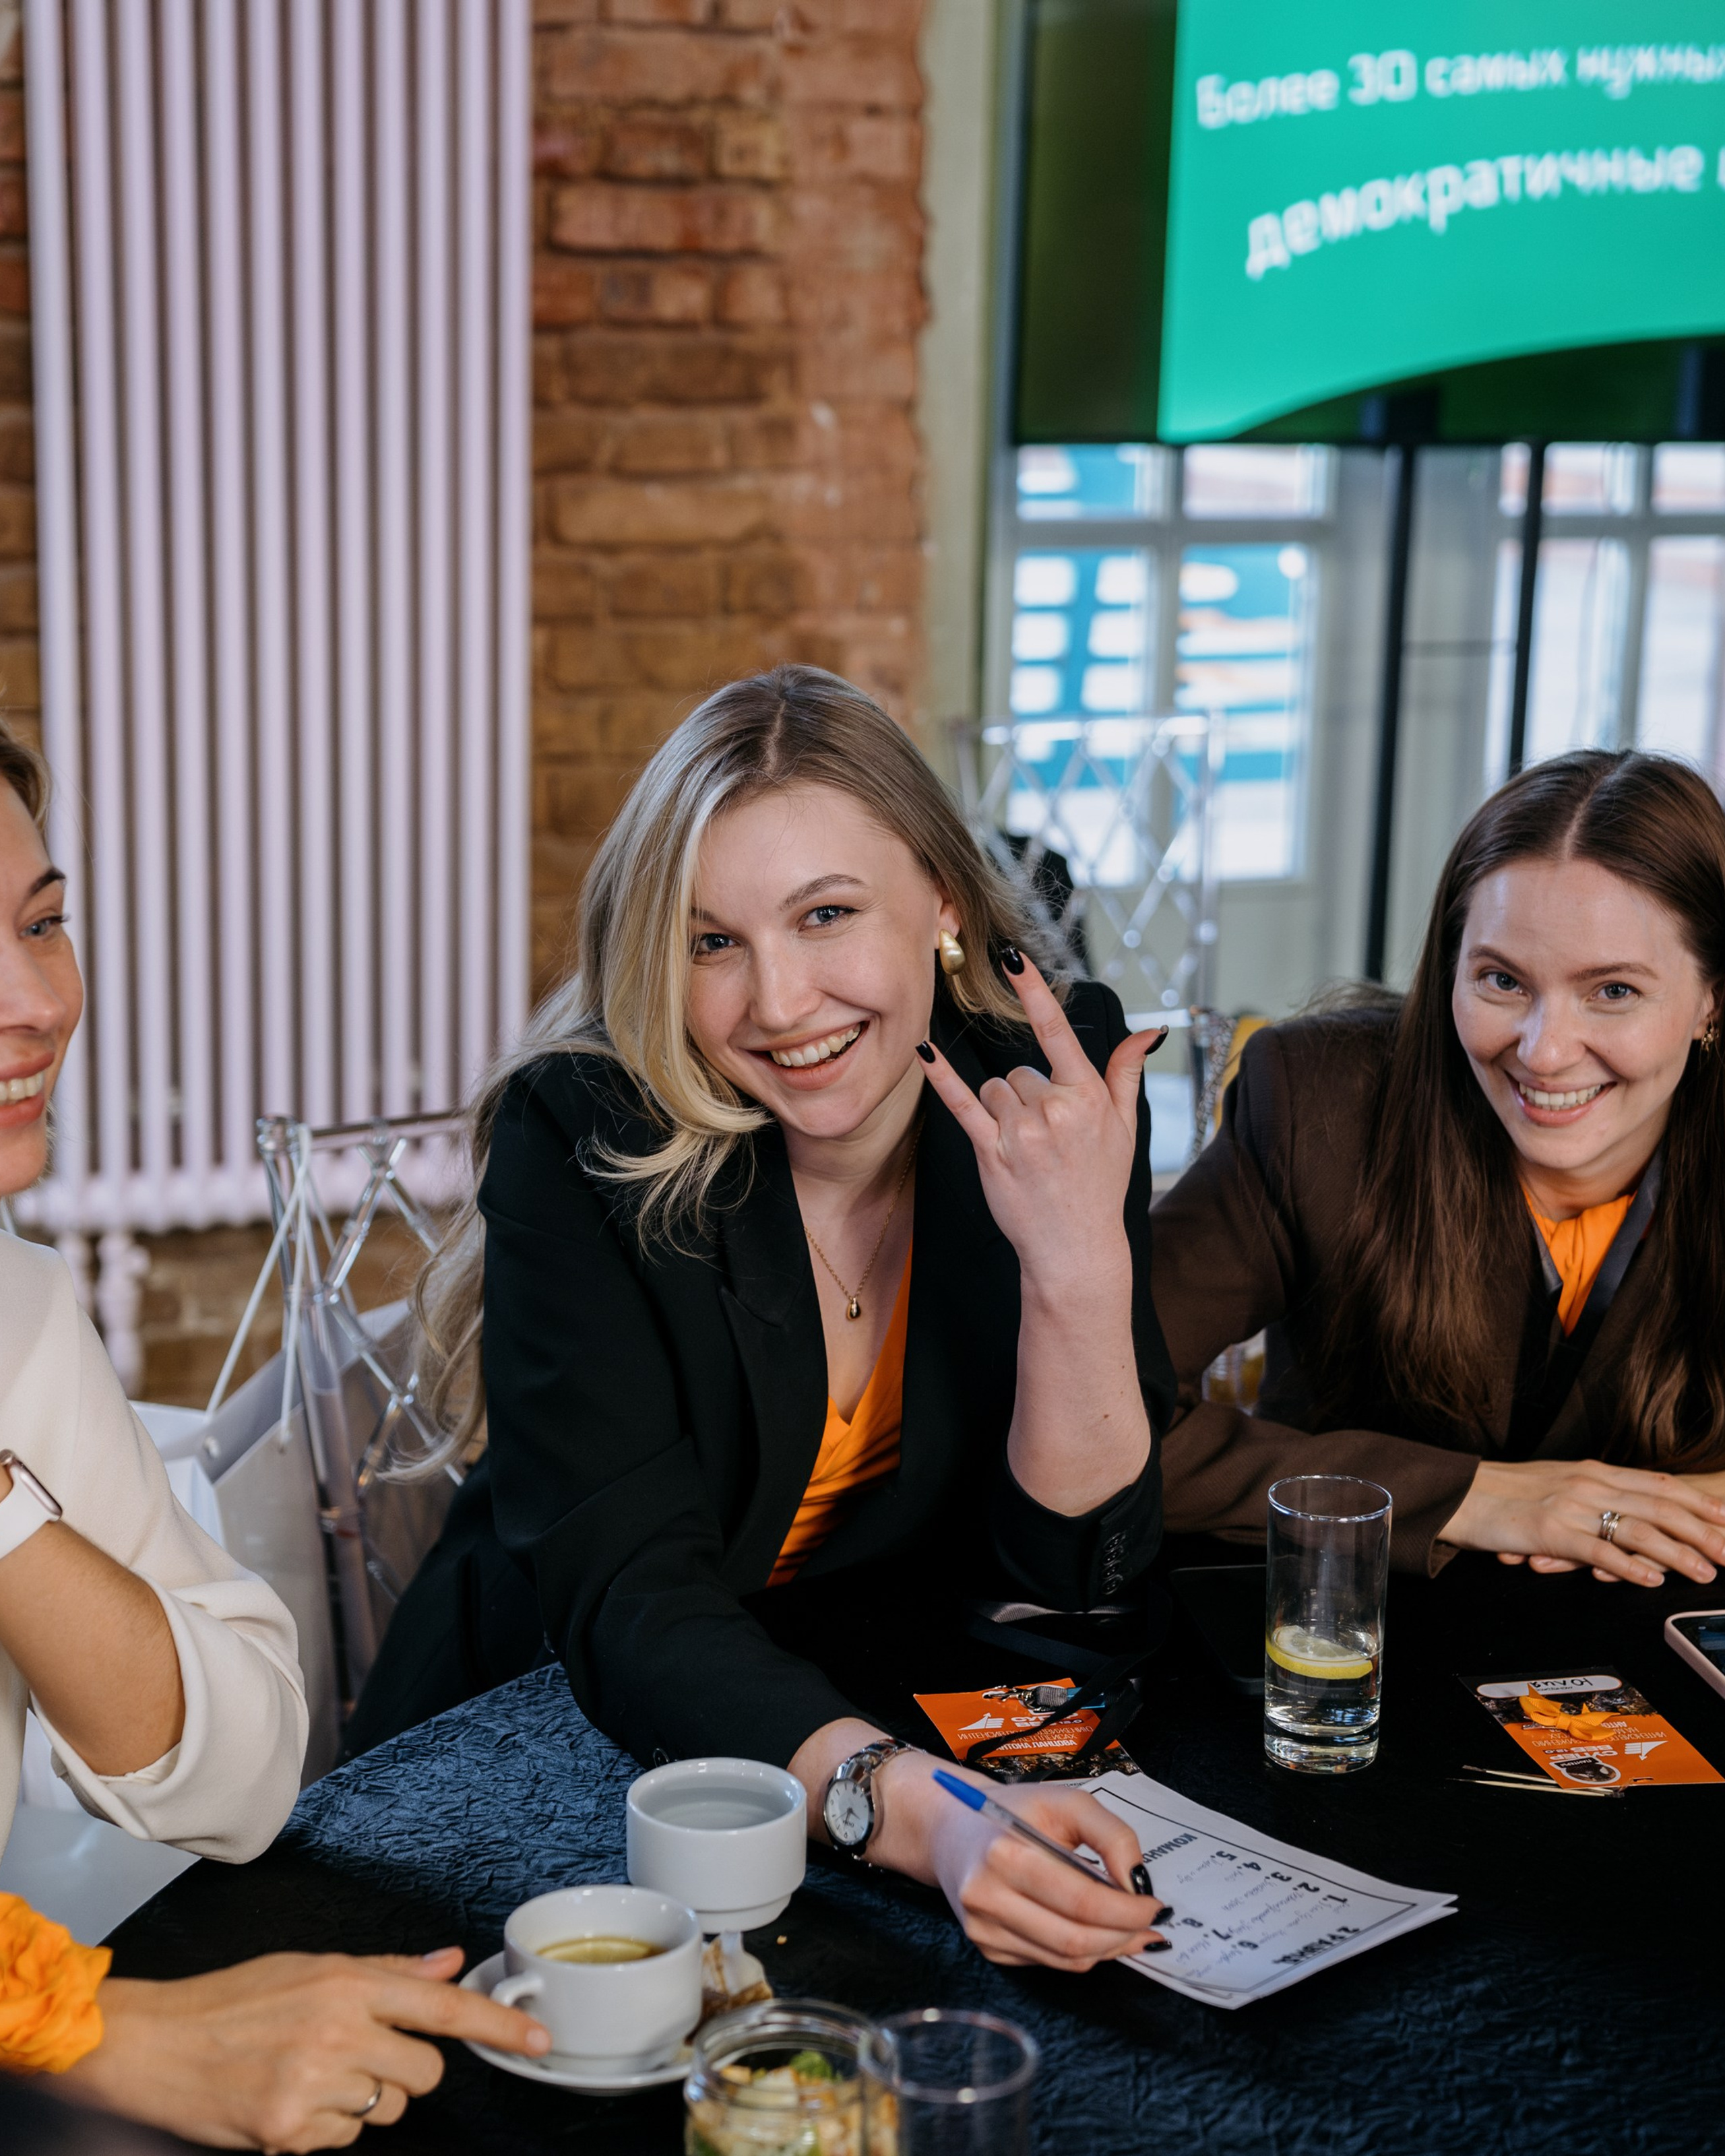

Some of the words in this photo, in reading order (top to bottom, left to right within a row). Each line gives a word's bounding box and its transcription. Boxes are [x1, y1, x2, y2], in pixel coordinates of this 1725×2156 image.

[1197, 69, 1340, 129] Более
[1348, 49, 1418, 105] 30
[1424, 46, 1569, 98] самых
[1245, 144, 1705, 281] демократичные
[1530, 1678, 1593, 1688] Юлия
[1032, 1740, 1078, 1748] ЛАНЦОВА
[1550, 1750, 1618, 1760] СУПЕР
[1143, 1833, 1197, 1864] КОМАНД
